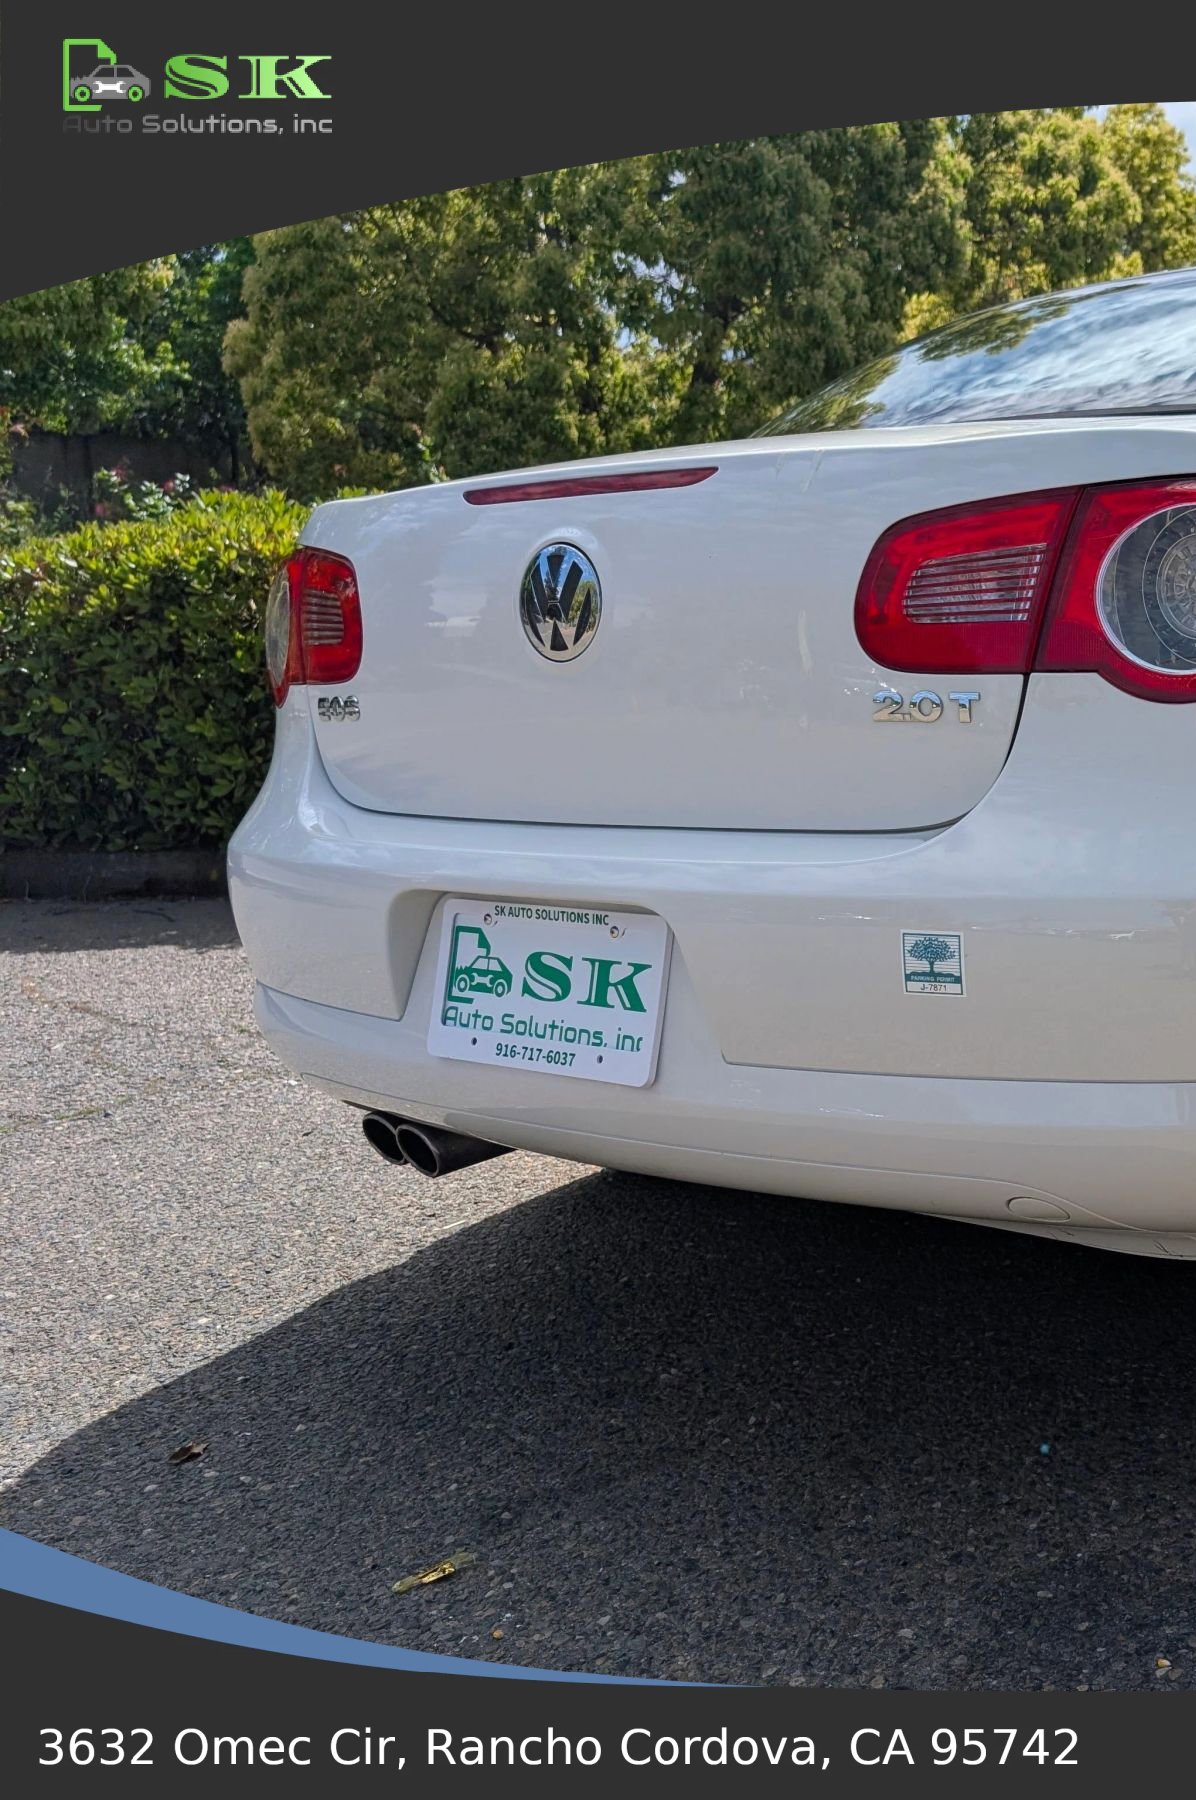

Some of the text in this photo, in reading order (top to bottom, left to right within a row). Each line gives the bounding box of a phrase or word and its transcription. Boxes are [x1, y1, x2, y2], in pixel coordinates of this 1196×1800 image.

[494, 905, 610, 927] SK AUTO SOLUTIONS INC
[521, 951, 652, 1013] SK
[920, 983, 947, 992] J-7871
[442, 1006, 494, 1032] Auto
[500, 1013, 608, 1049] Solutions,
[495, 1043, 576, 1067] 916-717-6037
